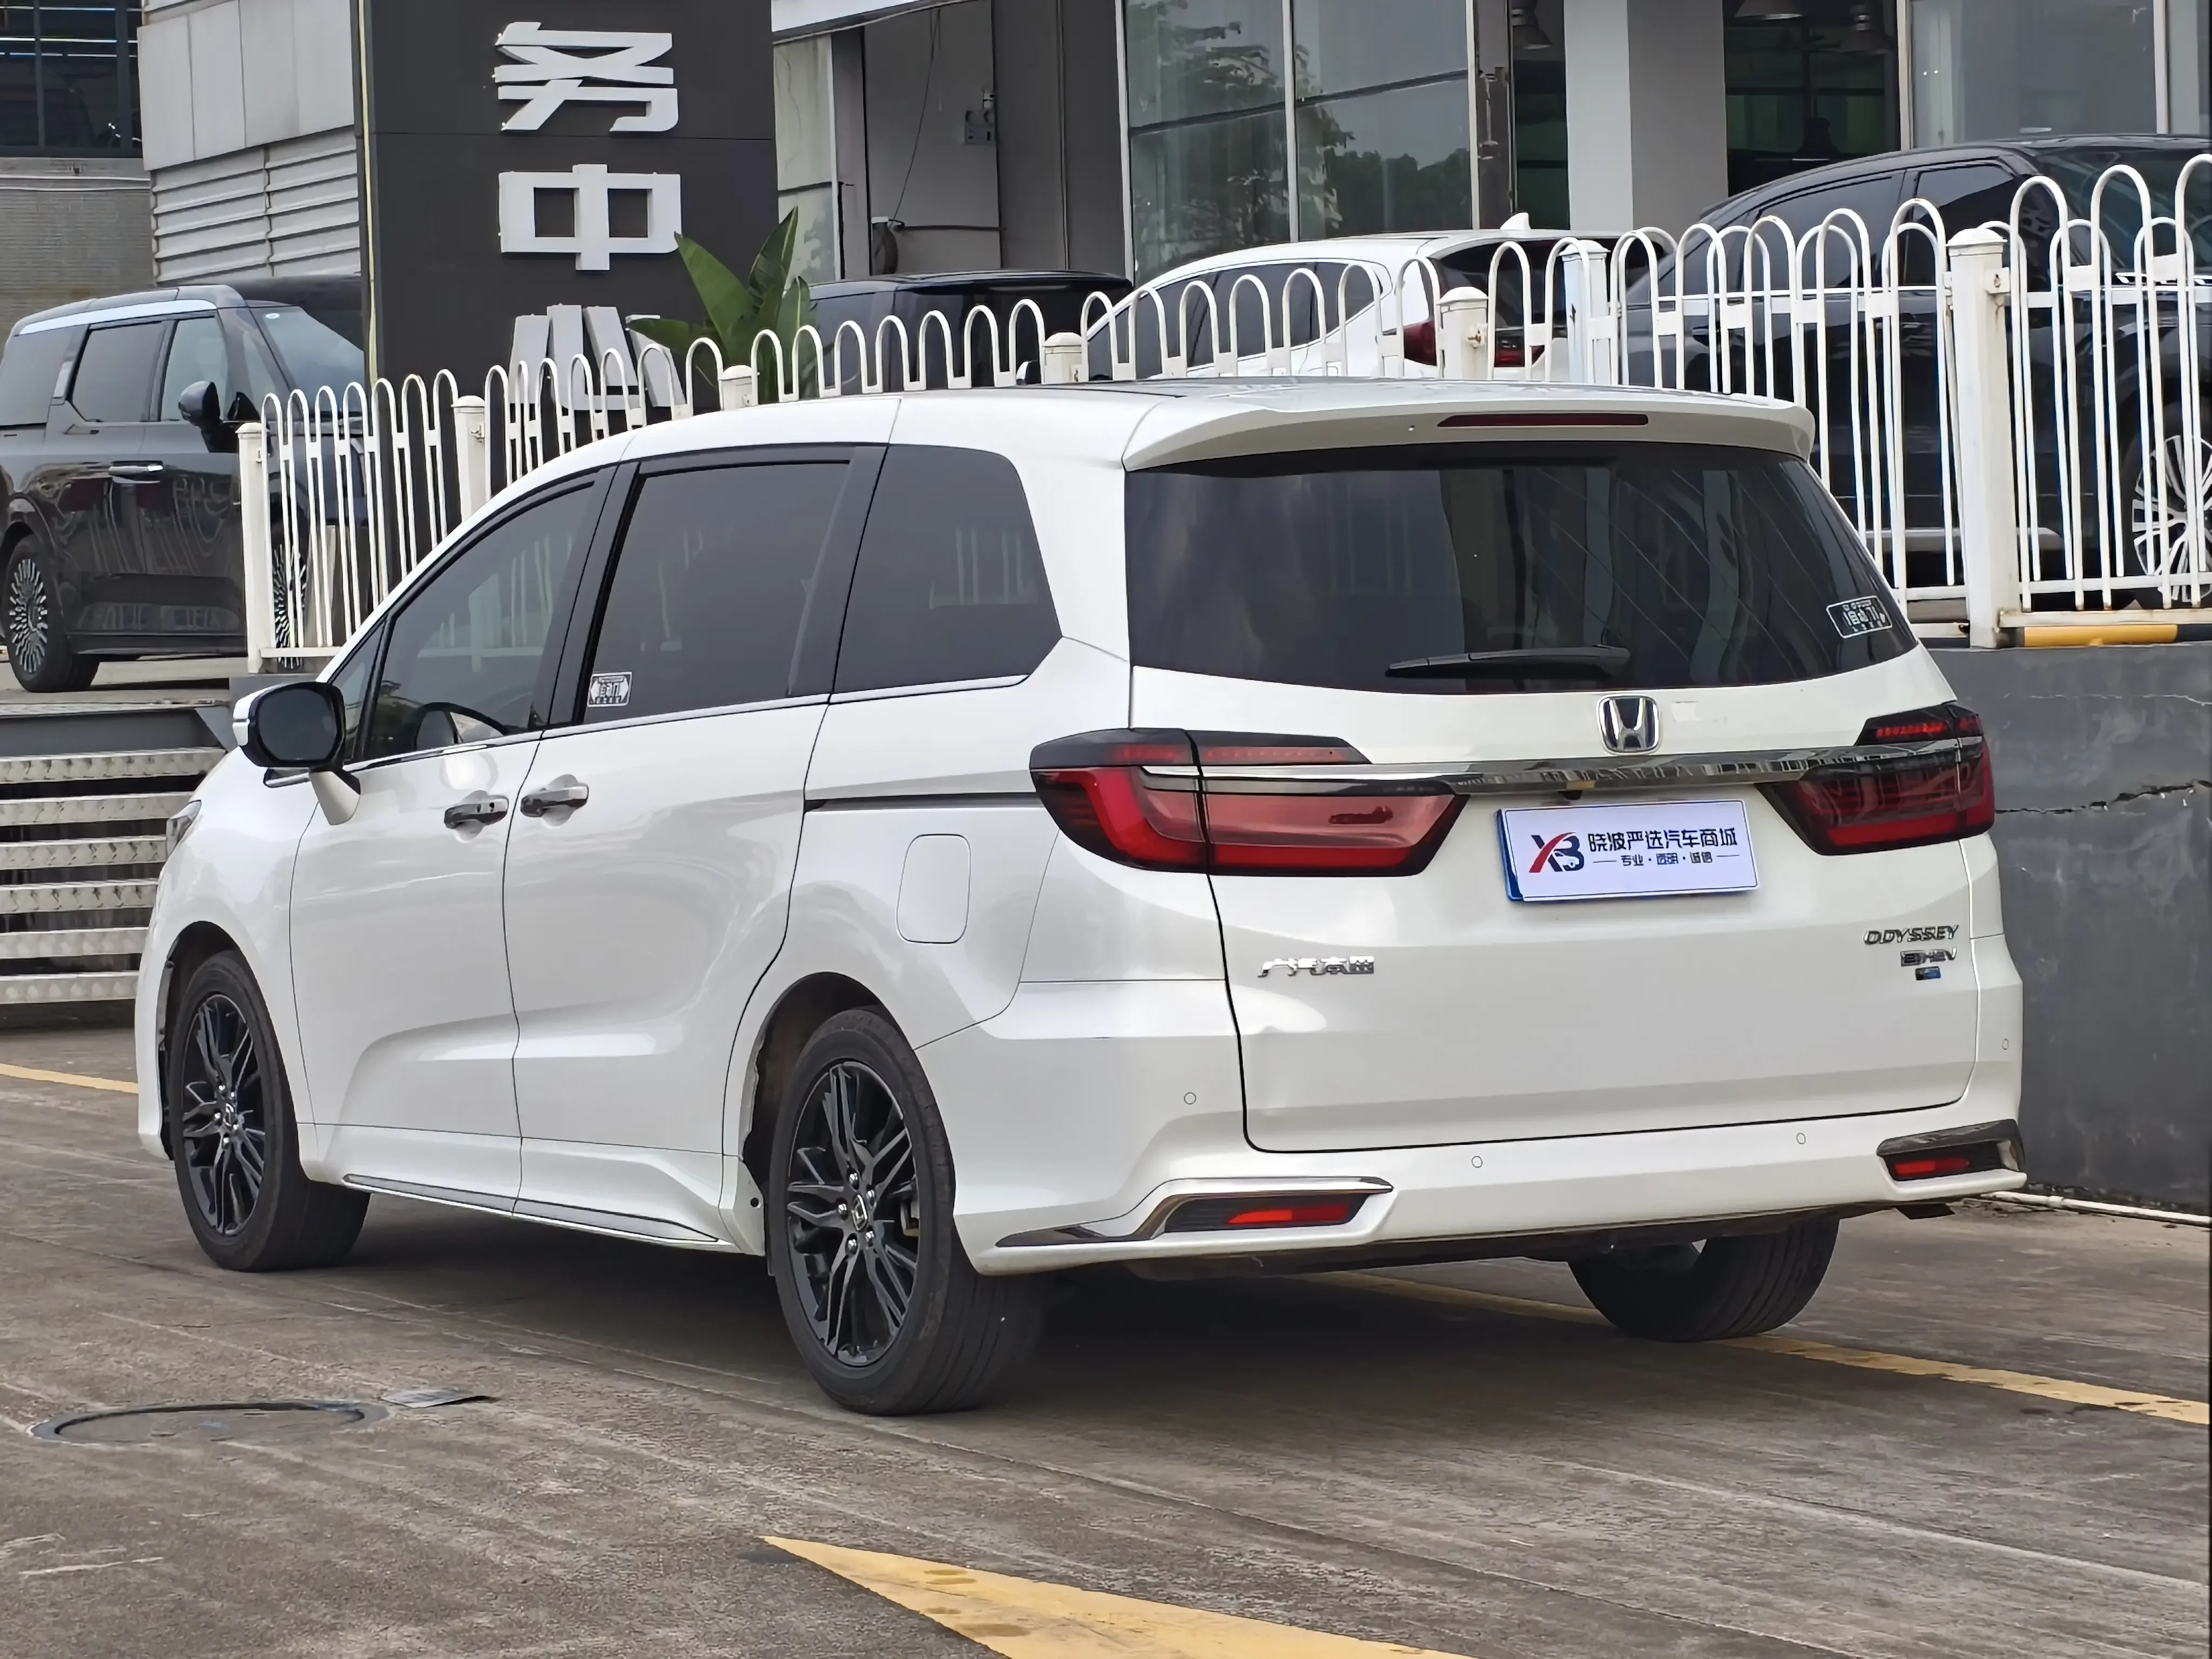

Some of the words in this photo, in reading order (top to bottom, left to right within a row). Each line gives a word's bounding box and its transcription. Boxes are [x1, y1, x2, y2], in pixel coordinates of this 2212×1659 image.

[1588, 827, 1738, 852] 晓波严选汽车商城
[1864, 924, 1959, 945] ODYSSEY
